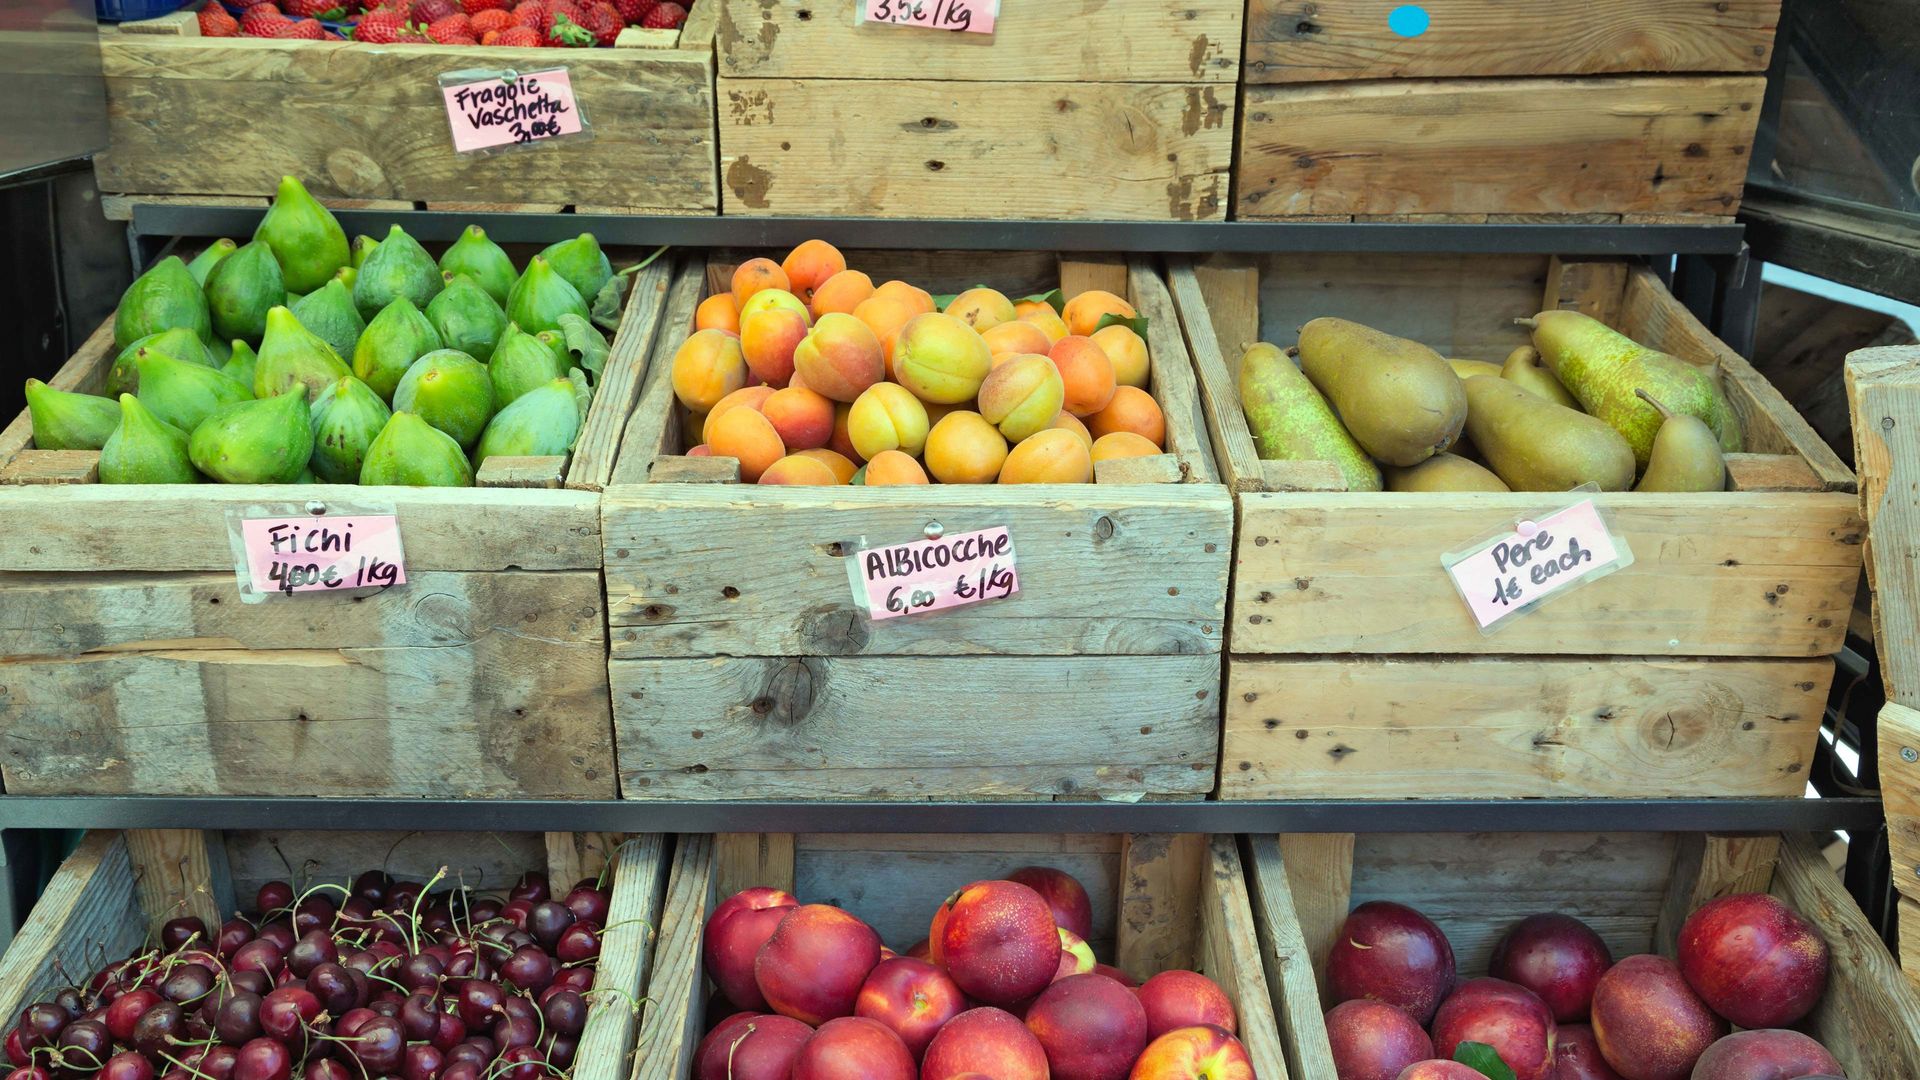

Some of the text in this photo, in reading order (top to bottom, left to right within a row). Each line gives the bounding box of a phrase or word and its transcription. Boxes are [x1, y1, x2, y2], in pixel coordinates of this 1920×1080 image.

[268, 523, 353, 555] Fichi
[1491, 530, 1554, 574] Pere
[1530, 537, 1592, 585] each
